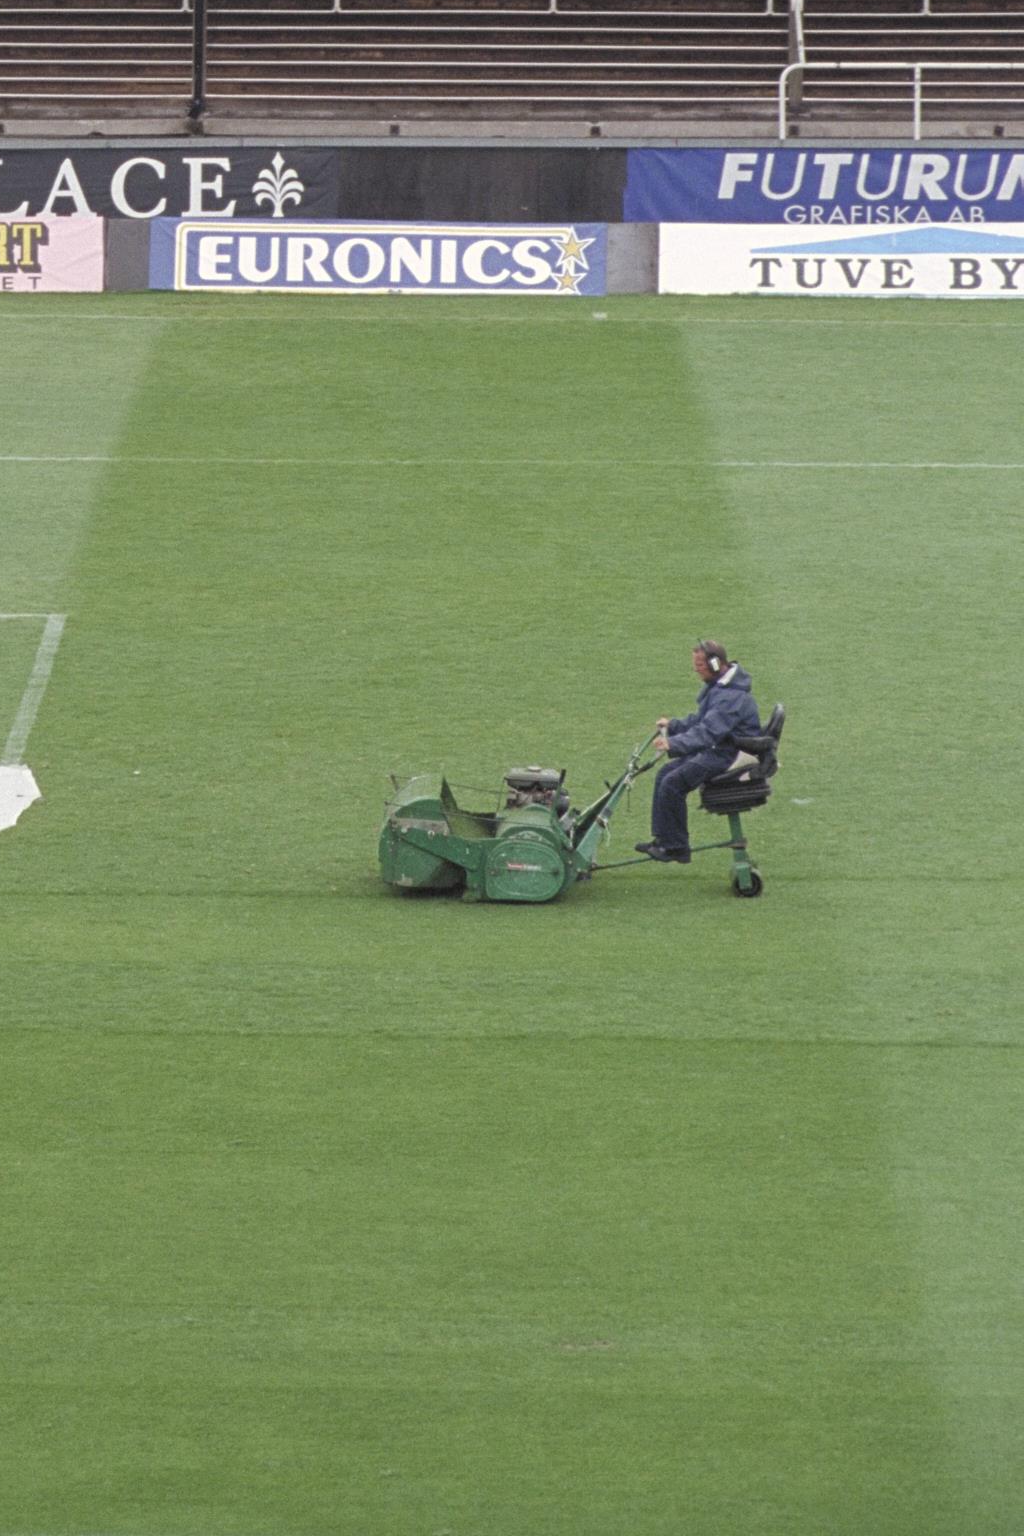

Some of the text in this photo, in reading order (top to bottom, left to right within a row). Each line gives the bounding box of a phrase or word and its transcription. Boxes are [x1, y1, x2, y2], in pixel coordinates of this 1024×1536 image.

[783, 205, 985, 224] GRAFISKA AB
[198, 236, 554, 285] EURONICS
[749, 257, 915, 289] TUVE
